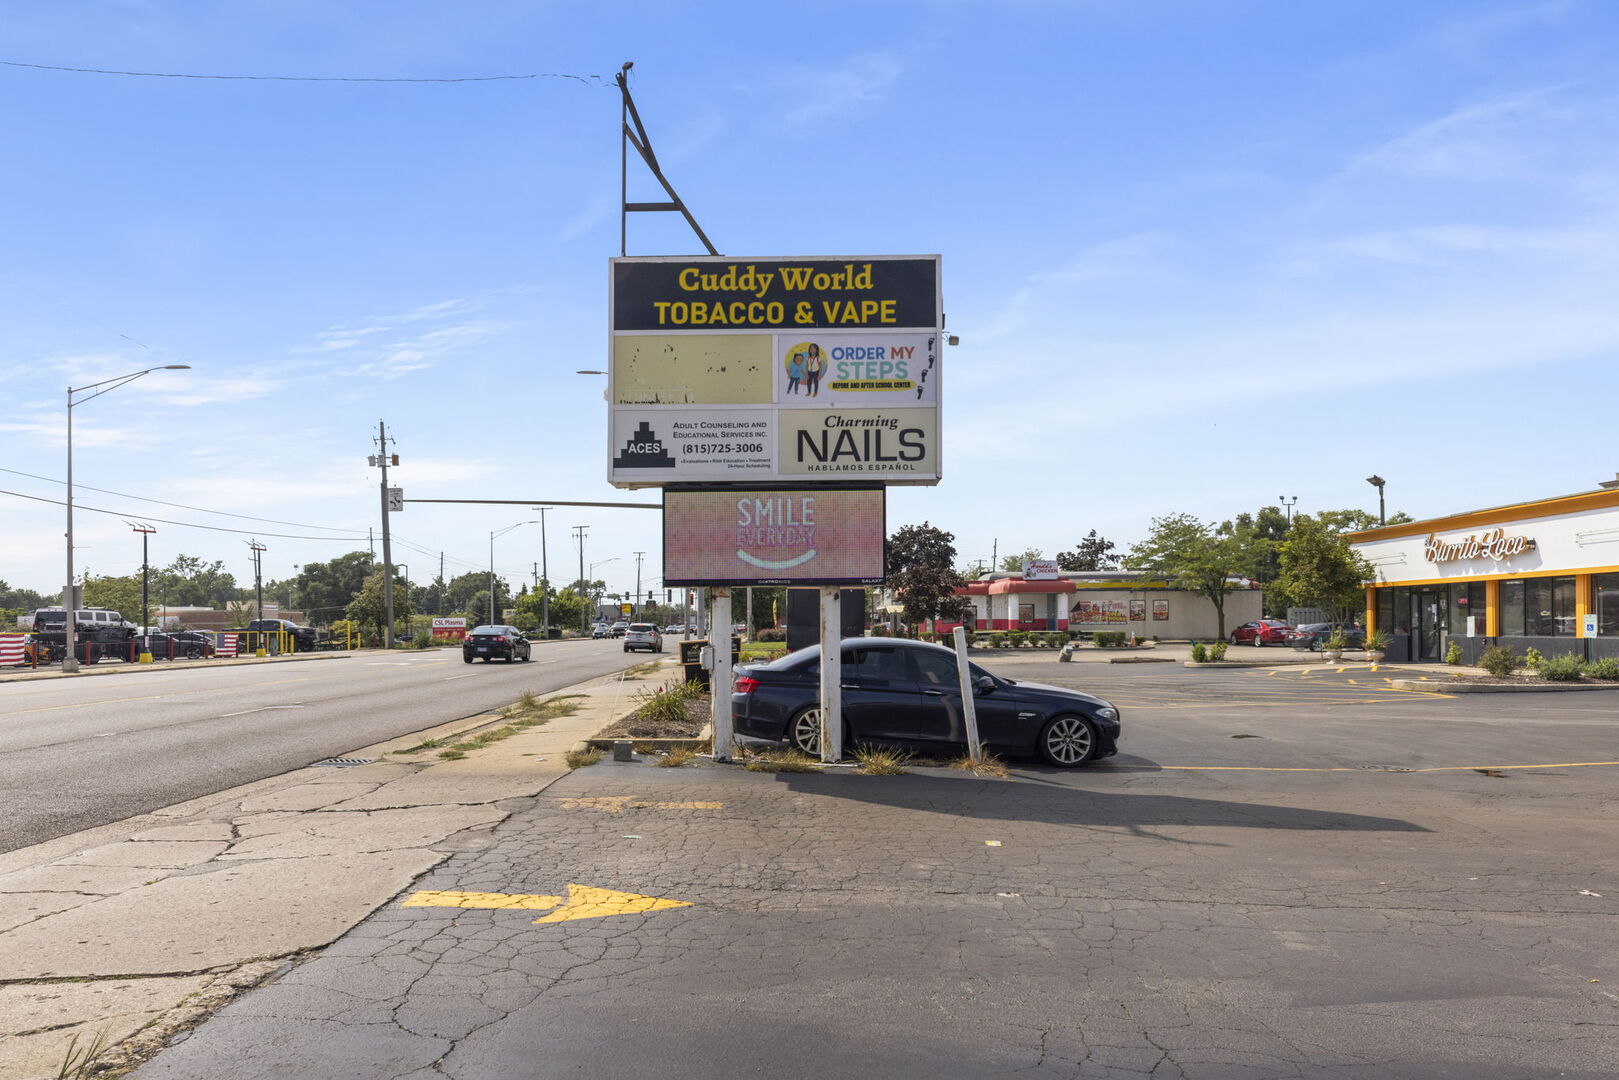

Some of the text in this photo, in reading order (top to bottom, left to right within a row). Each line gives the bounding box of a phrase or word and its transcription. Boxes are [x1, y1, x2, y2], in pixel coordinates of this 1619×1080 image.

[678, 264, 874, 298] Cuddy World
[653, 300, 897, 325] TOBACCO & VAPE
[831, 346, 915, 360] ORDER MY
[836, 361, 909, 380] STEPS
[700, 421, 749, 429] COUNSELING
[824, 415, 900, 430] Charming
[673, 431, 719, 439] EDUCATIONAL
[628, 443, 661, 453] ACES
[682, 443, 763, 455] (815)725-3006
[797, 428, 926, 462] NAILS
[868, 462, 915, 471] ESPAÑOL
[736, 496, 816, 526] SMILE
[736, 527, 816, 546] EVERYDAY
[1425, 527, 1526, 563] Burrito Loco
